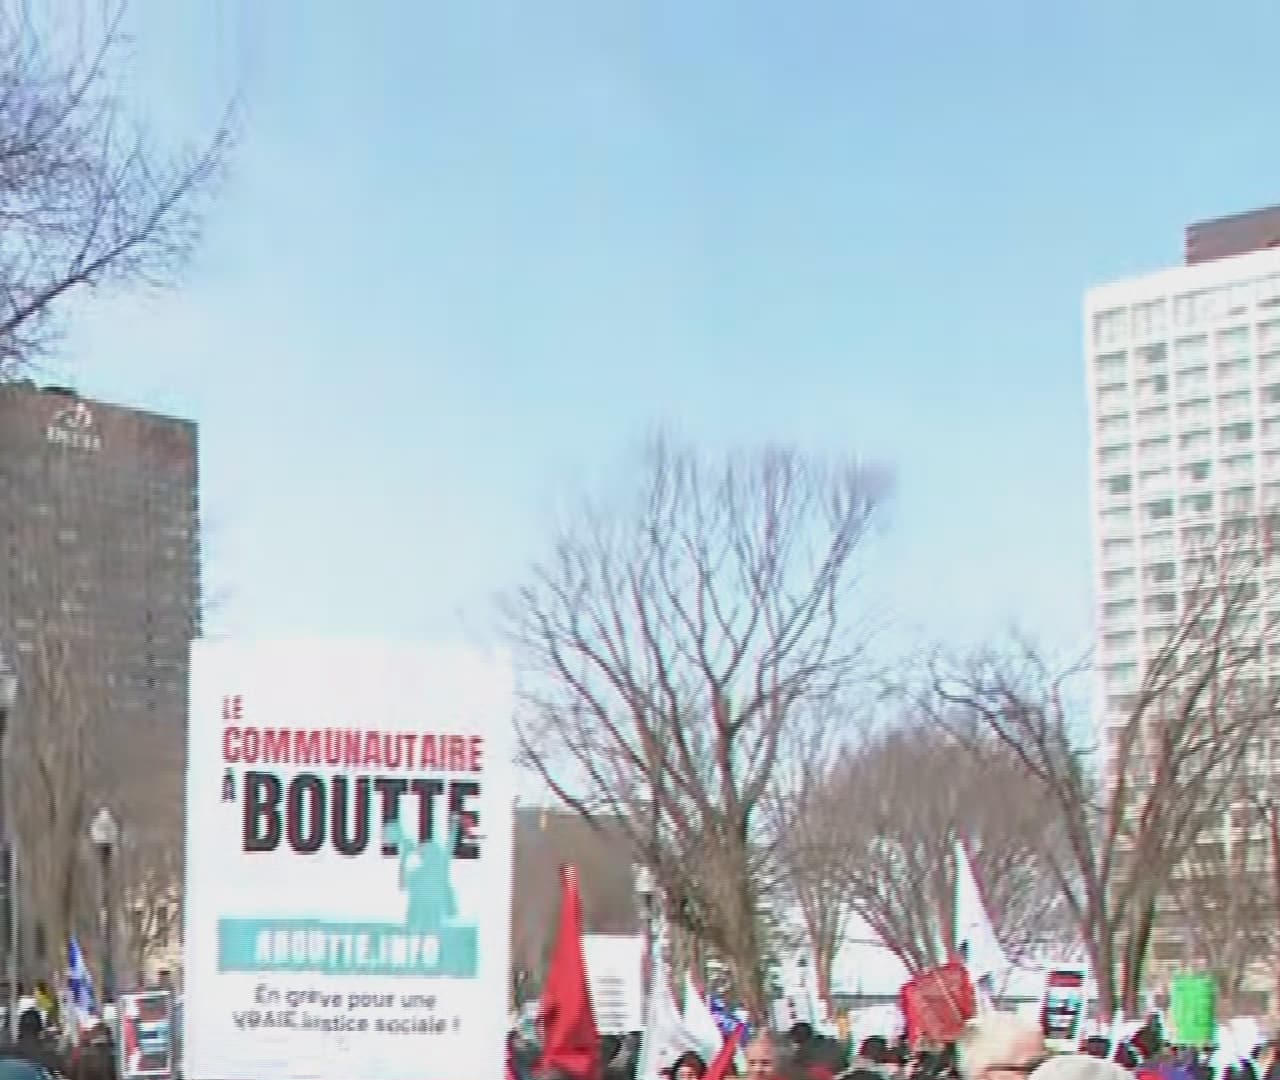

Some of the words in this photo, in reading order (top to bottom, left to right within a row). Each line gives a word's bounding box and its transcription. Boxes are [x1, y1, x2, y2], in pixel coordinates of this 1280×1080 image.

[223, 695, 243, 719] LE
[222, 727, 484, 771] COMMUNAUTAIRE
[242, 771, 480, 859] BOUTTE
[253, 982, 280, 1004] En
[347, 992, 396, 1010] pour
[399, 993, 437, 1010] une
[374, 1015, 448, 1035] sociale
